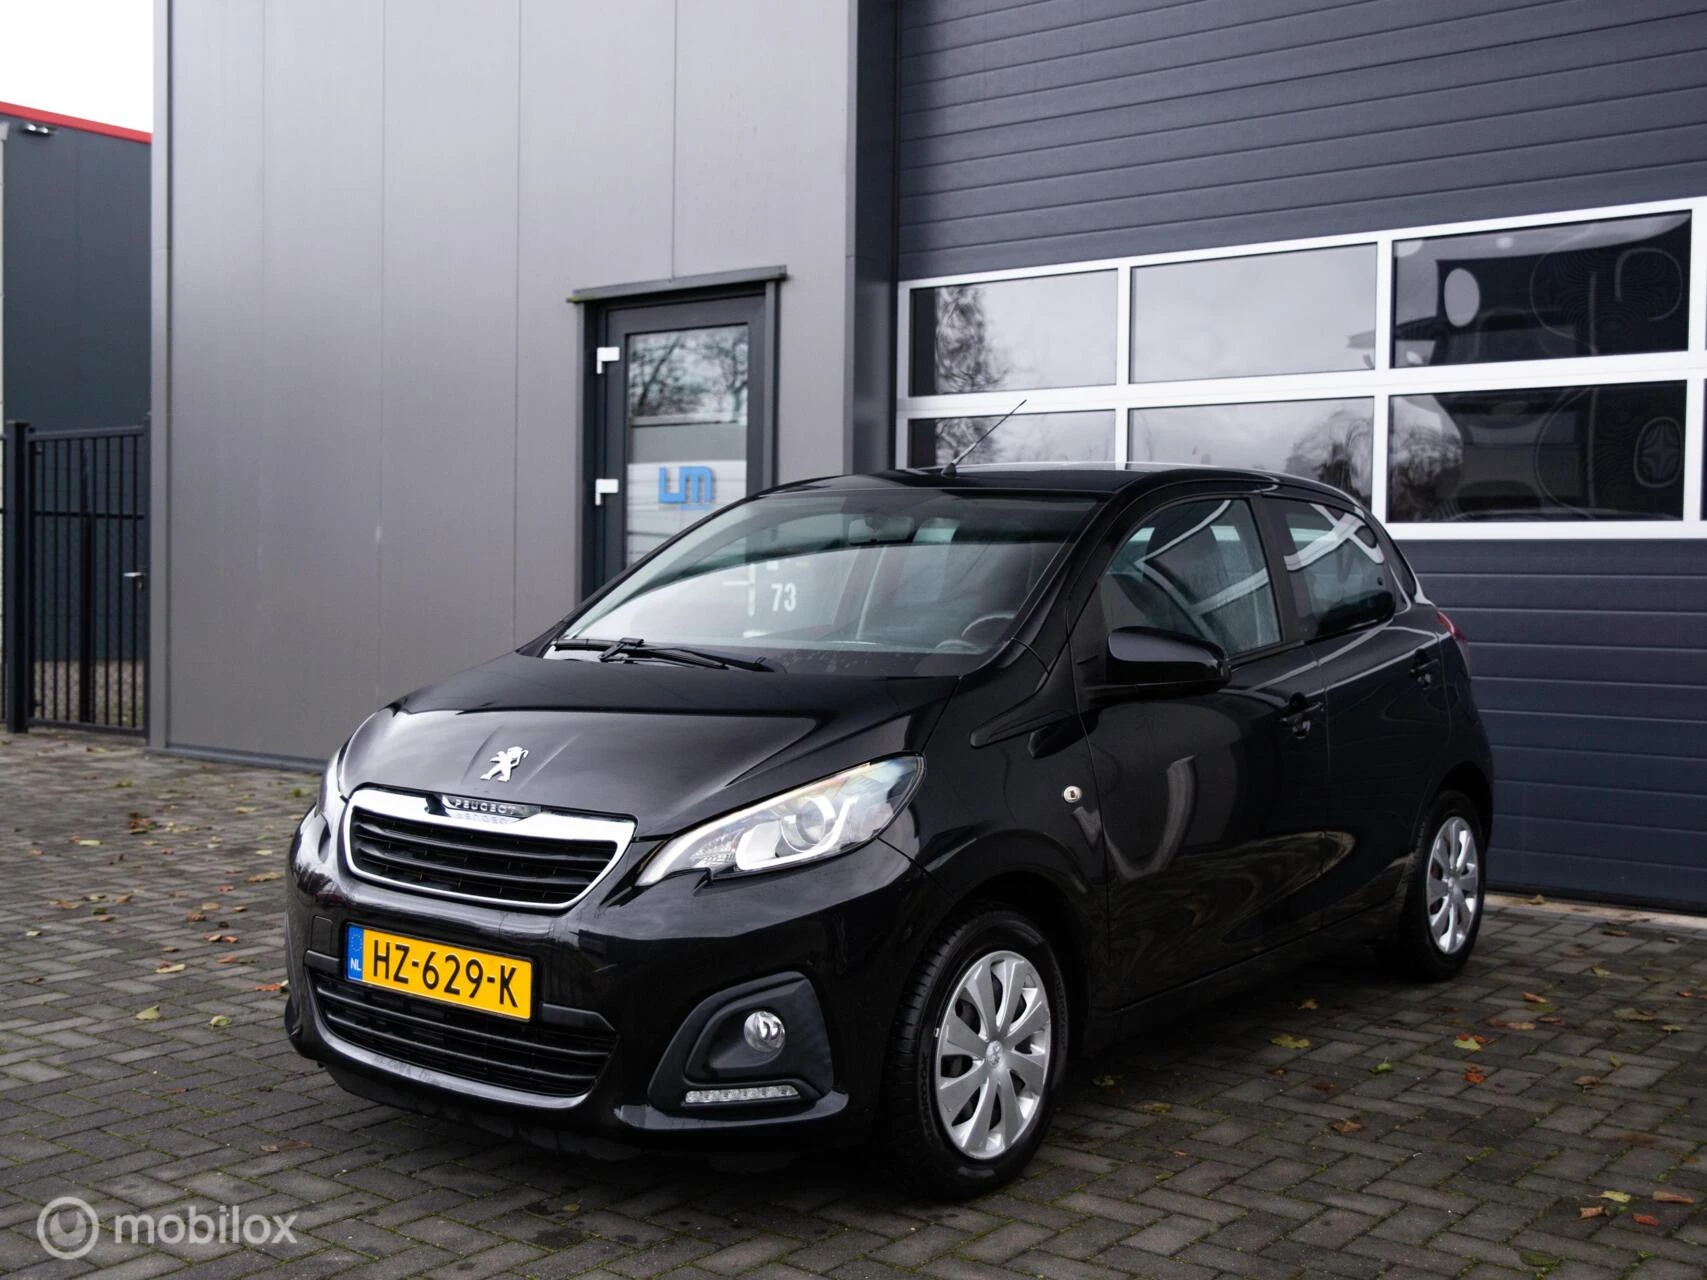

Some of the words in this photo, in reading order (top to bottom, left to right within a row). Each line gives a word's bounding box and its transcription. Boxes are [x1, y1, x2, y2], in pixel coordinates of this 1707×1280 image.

[771, 582, 797, 612] 73
[454, 798, 517, 815] PEUGEOT
[350, 959, 362, 971] NL
[373, 939, 519, 1008] HZ-629-K
